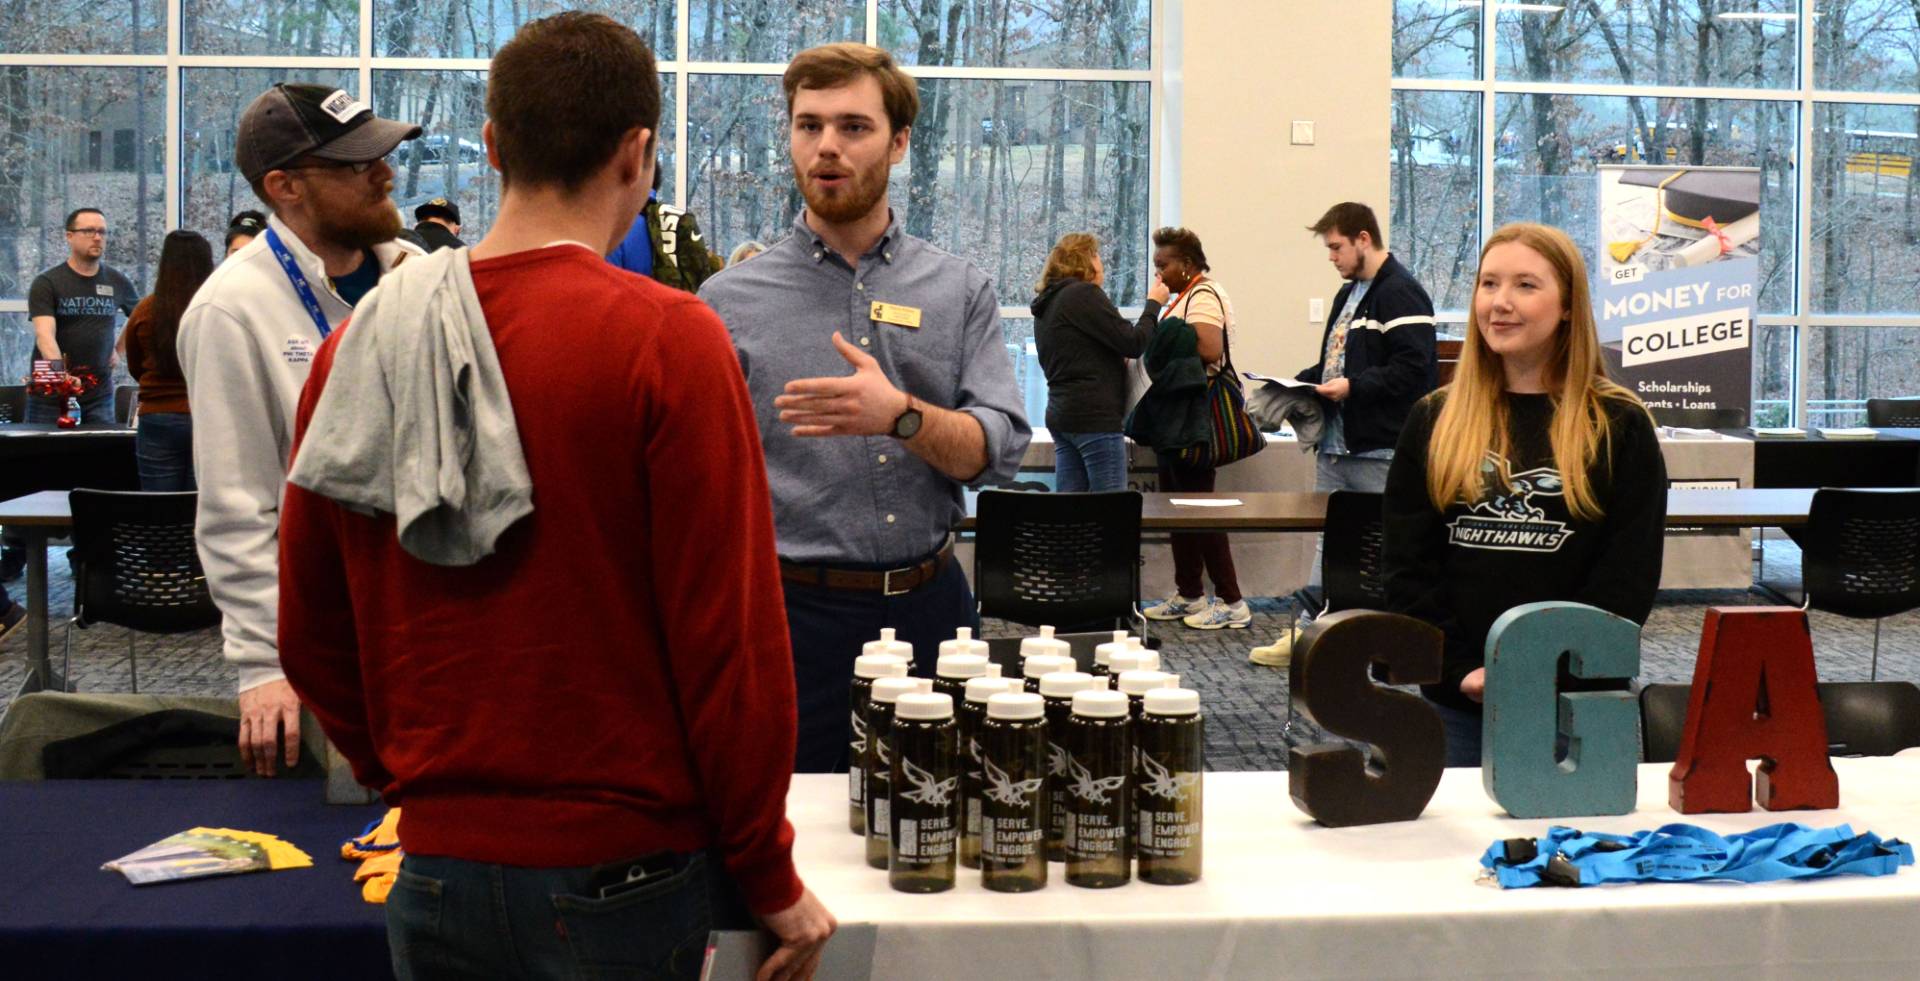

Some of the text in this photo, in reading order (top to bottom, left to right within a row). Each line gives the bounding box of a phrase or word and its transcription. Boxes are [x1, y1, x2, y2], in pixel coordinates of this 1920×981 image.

[1615, 268, 1637, 279] GET
[1603, 281, 1752, 320] MONEY FOR
[1627, 319, 1743, 355] COLLEGE
[1638, 381, 1711, 395] Scholarships
[1642, 399, 1716, 409] rants Loans
[1455, 527, 1561, 546] NIGHTHAWKS
